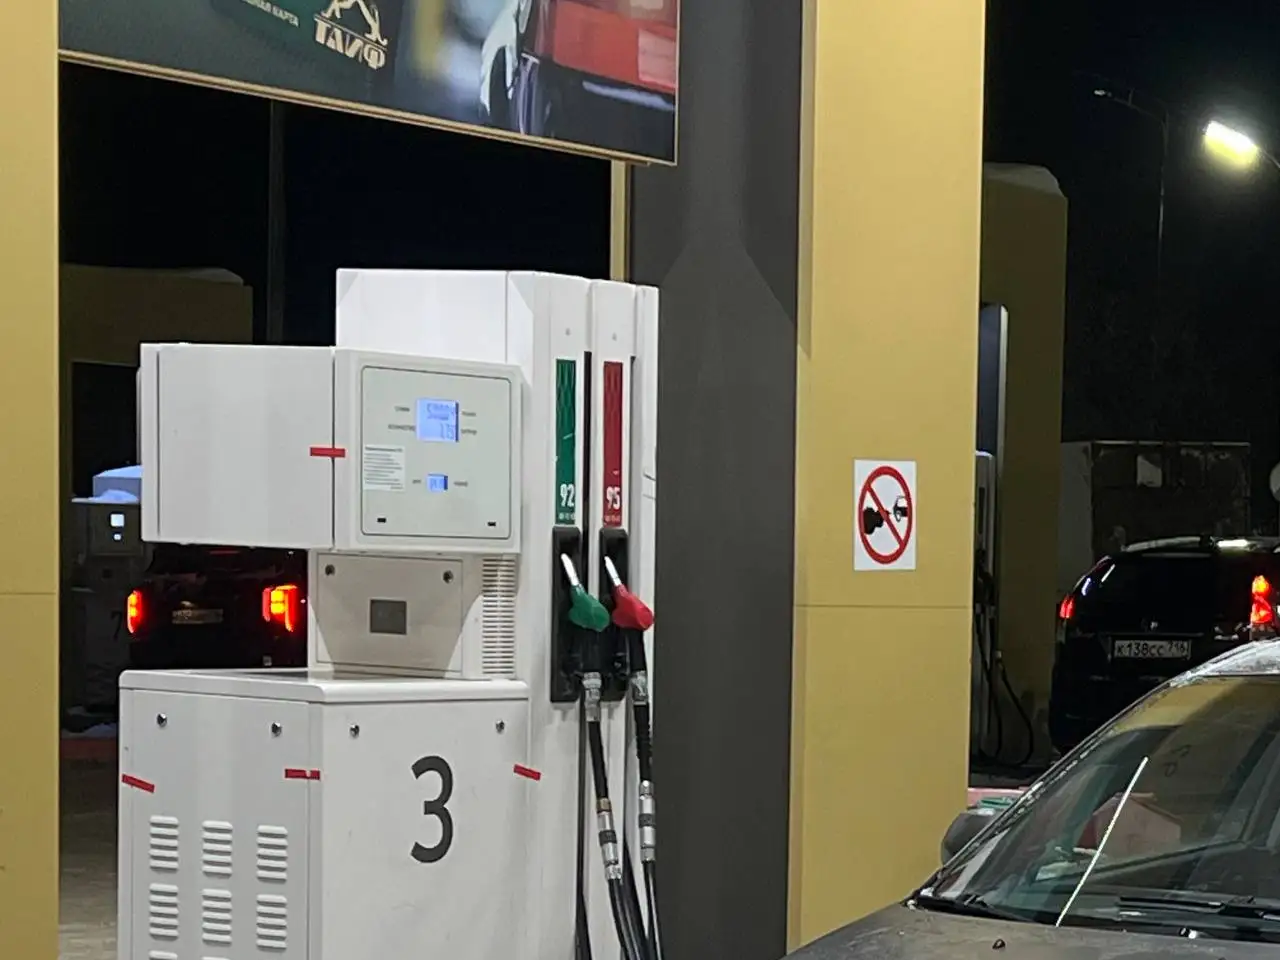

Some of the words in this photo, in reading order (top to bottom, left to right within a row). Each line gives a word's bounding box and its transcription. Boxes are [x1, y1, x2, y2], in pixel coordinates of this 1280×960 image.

[314, 18, 387, 70] ТАИФ
[560, 483, 575, 507] 92
[606, 486, 621, 510] 95
[411, 755, 454, 863] 3
